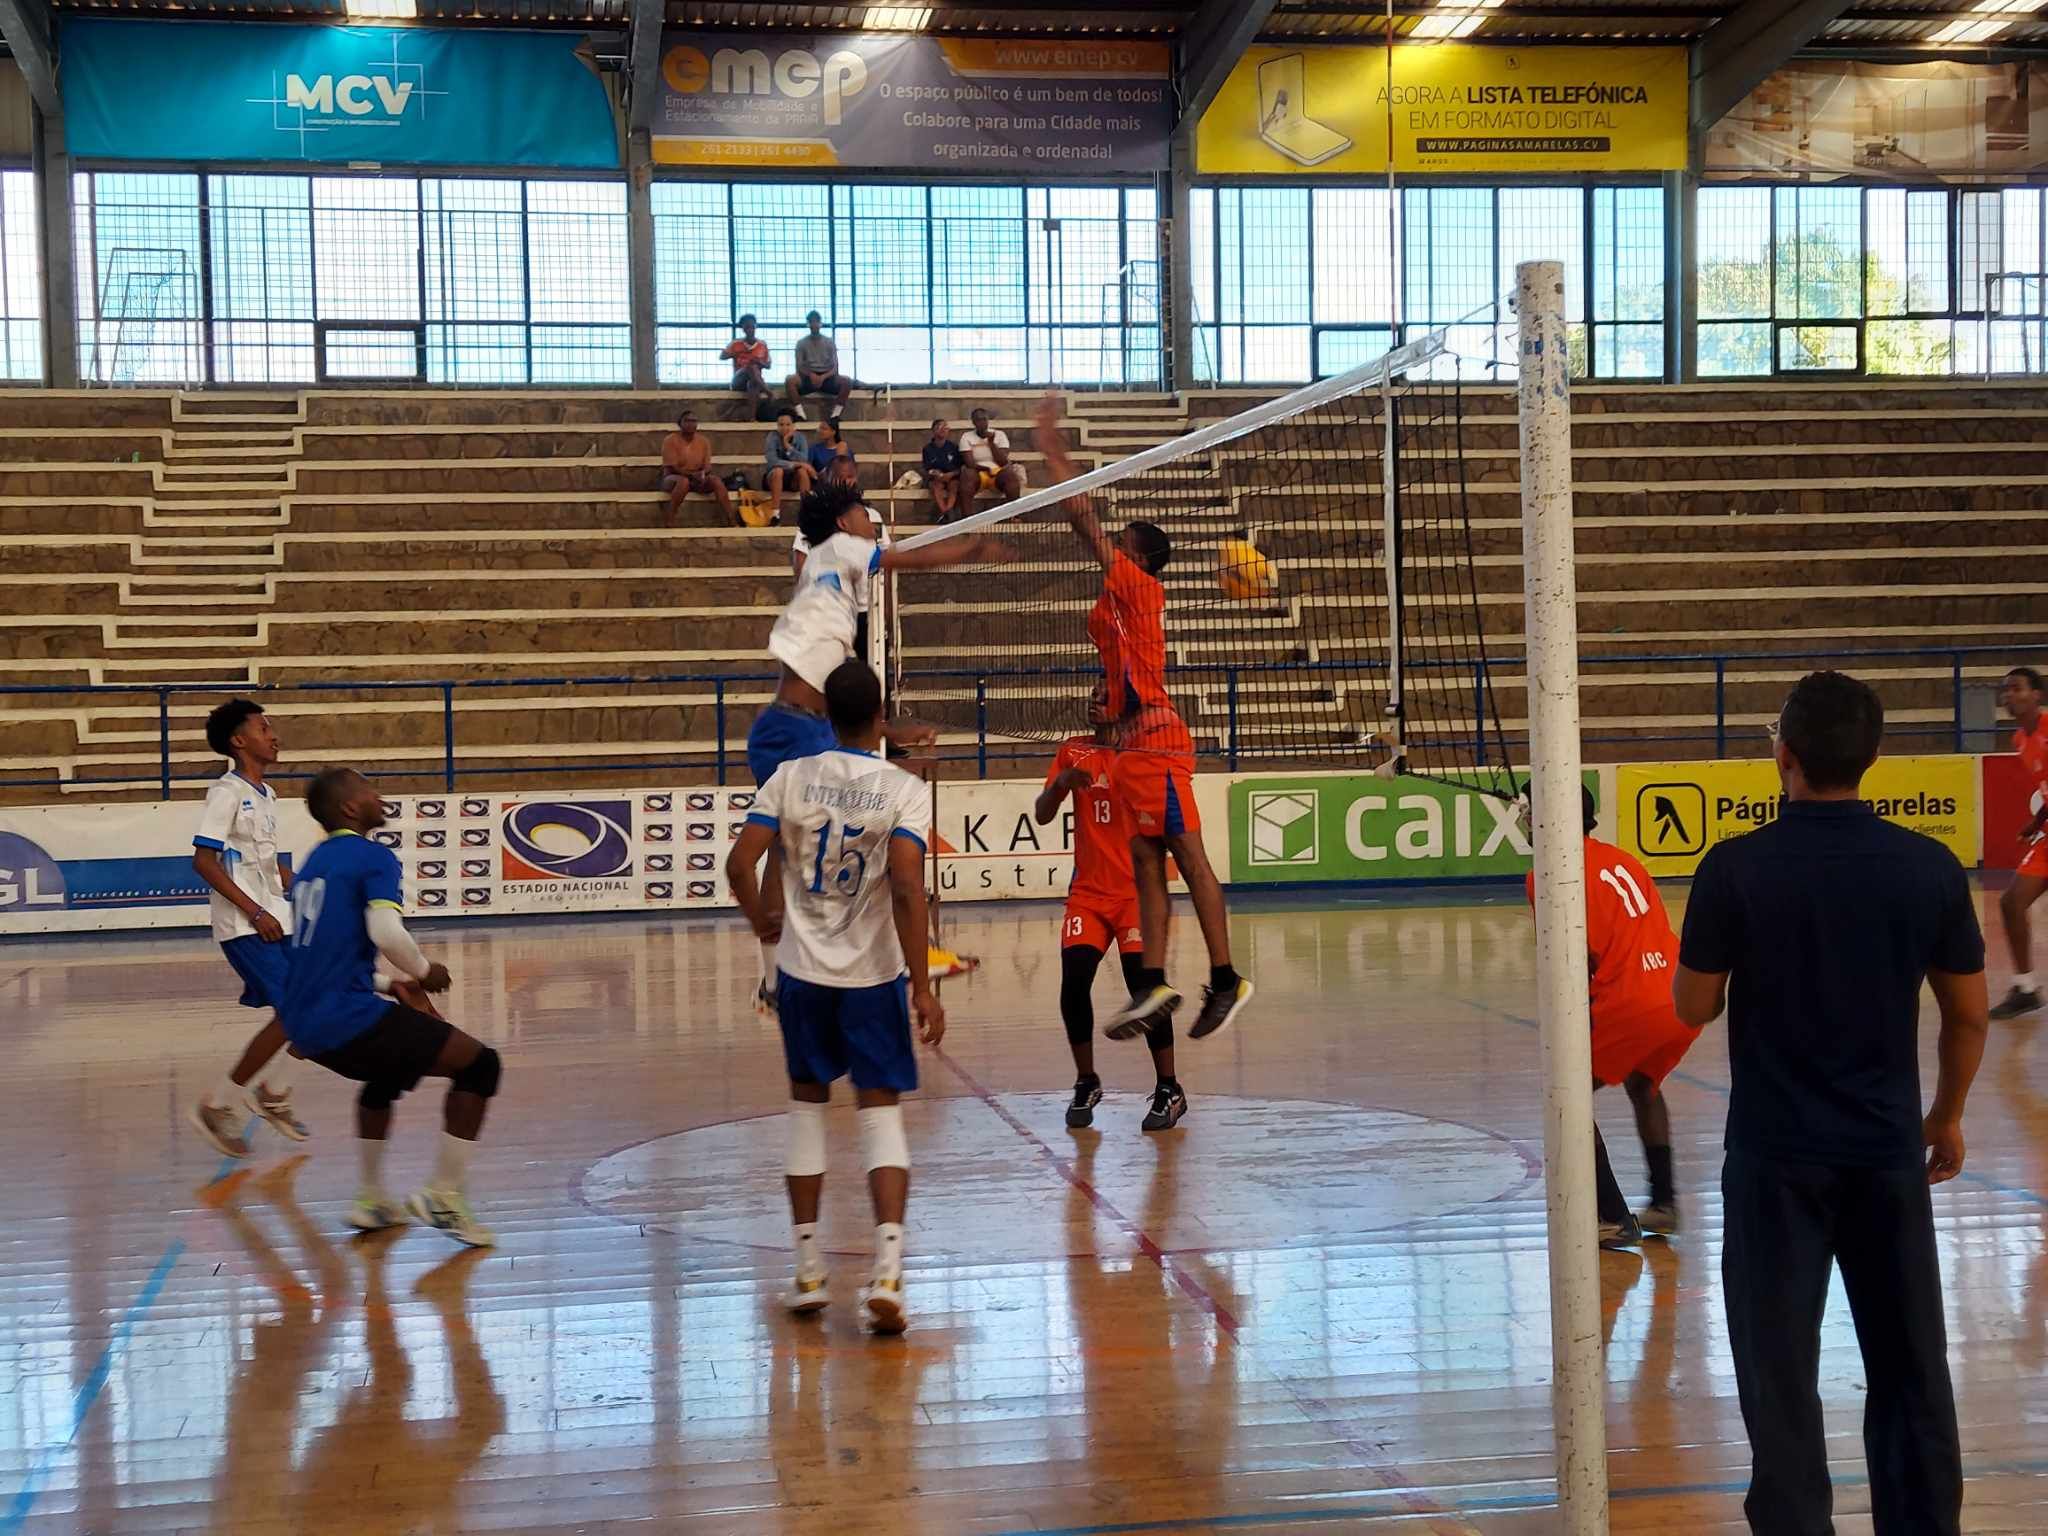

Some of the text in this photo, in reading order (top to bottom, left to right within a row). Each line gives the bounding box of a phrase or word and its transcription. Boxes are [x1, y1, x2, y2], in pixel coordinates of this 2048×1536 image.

[286, 74, 413, 115] MCV
[663, 46, 868, 125] emep
[880, 83, 1163, 103] O espaço público é um bem de todos!
[1376, 81, 1648, 104] AGORA A LISTA TELEFÓNICA
[903, 112, 1142, 130] Colabore para uma Cidade mais
[1409, 110, 1618, 129] EM FORMATO DIGITAL
[933, 143, 1112, 159] organizada e ordenada!
[1426, 140, 1599, 151] WWW.PAGINASAMARELAS.CV
[1094, 800, 1111, 824] 13
[806, 819, 866, 898] 15
[503, 881, 629, 894] ESTADIO NACIONAL
[1599, 864, 1650, 918] 11
[1066, 916, 1082, 936] 13
[1641, 951, 1668, 972] ABC
